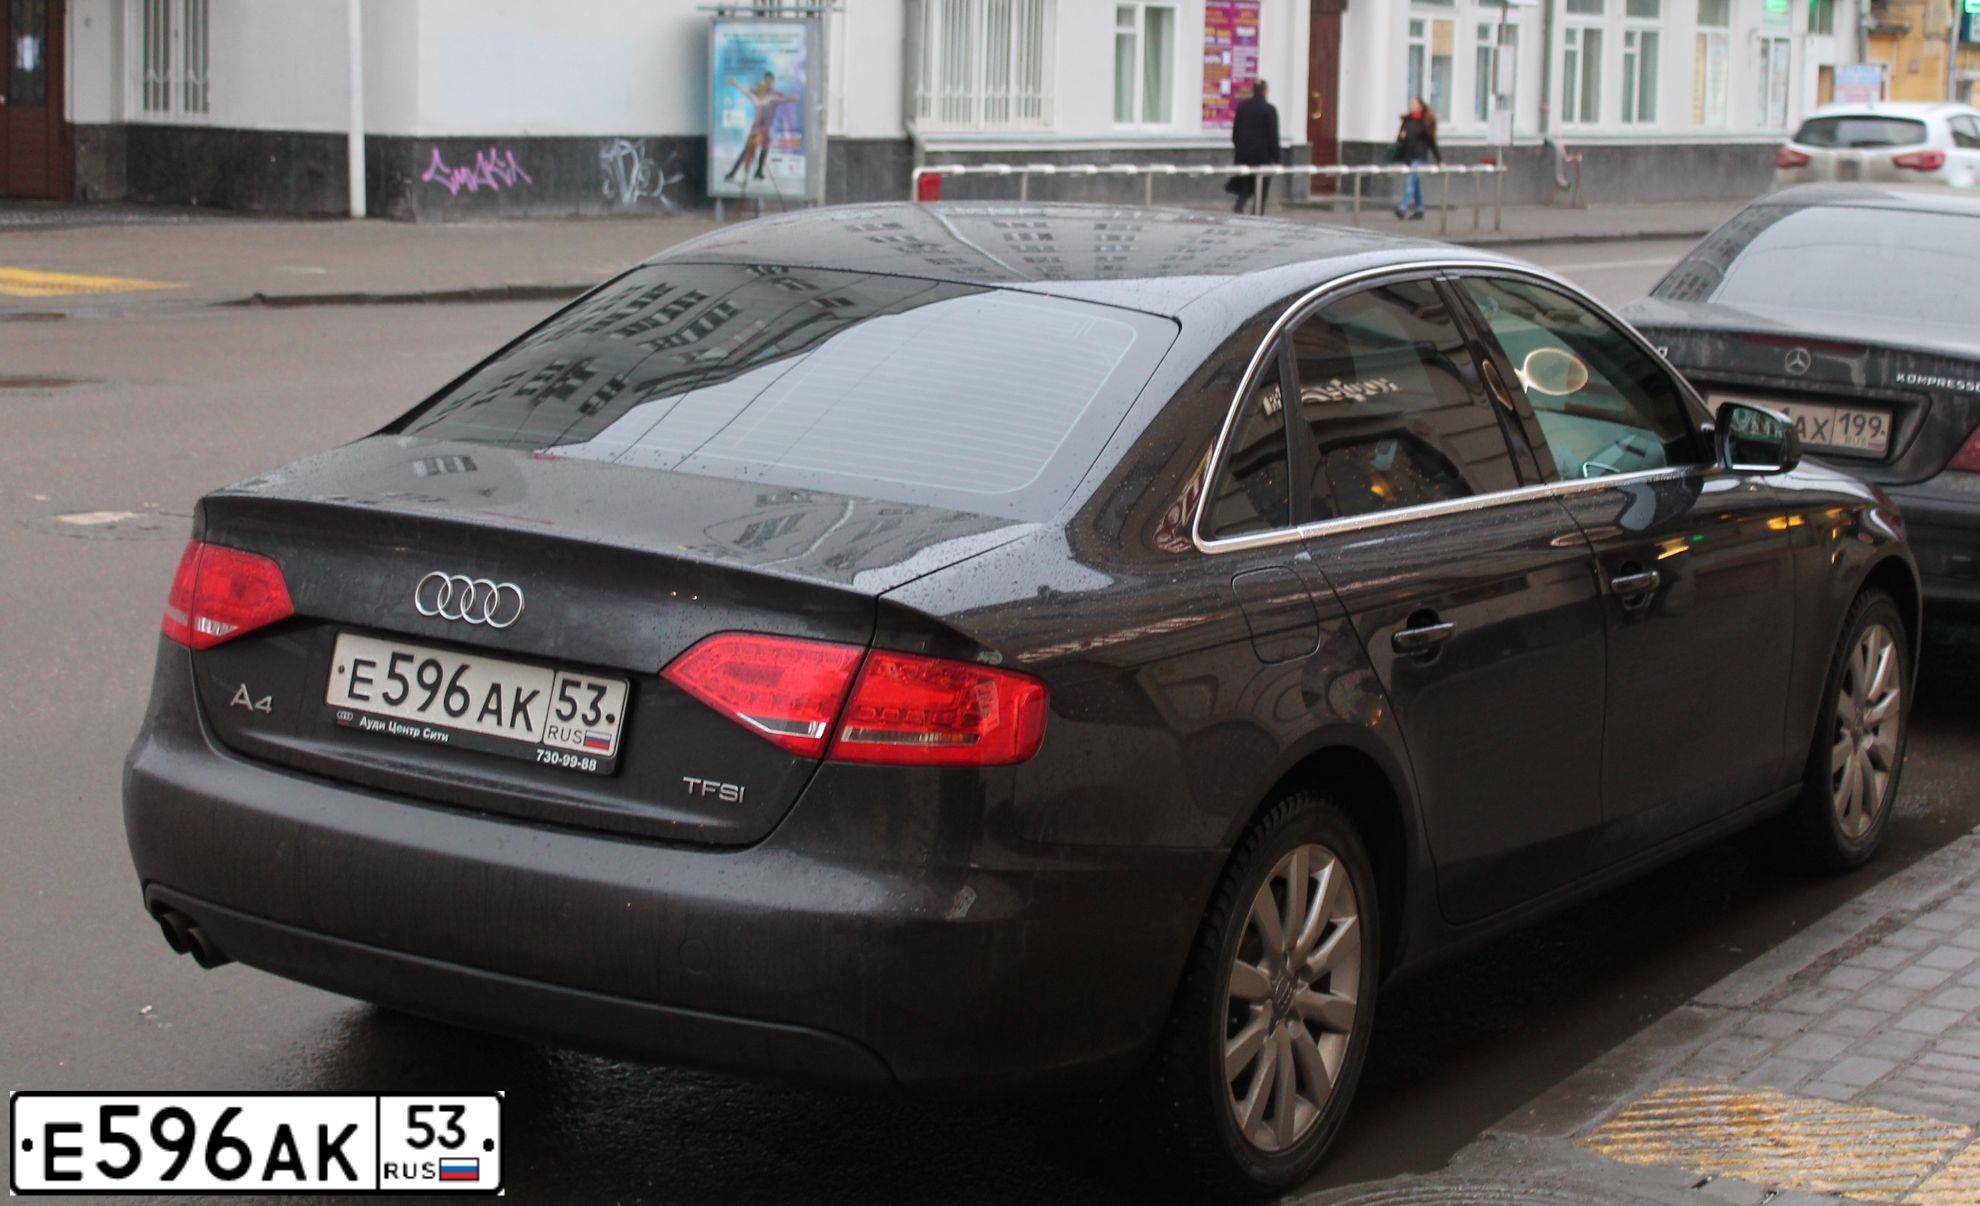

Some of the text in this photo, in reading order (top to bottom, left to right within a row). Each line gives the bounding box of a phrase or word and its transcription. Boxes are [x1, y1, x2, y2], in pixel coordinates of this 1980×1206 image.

[1839, 412, 1882, 438] 199
[230, 683, 273, 714] A4
[348, 651, 607, 732] E596AK 53
[359, 716, 449, 742] Ауди Центр Сити
[547, 724, 583, 744] RUS
[536, 749, 597, 771] 730-99-88
[682, 776, 745, 803] TFSI
